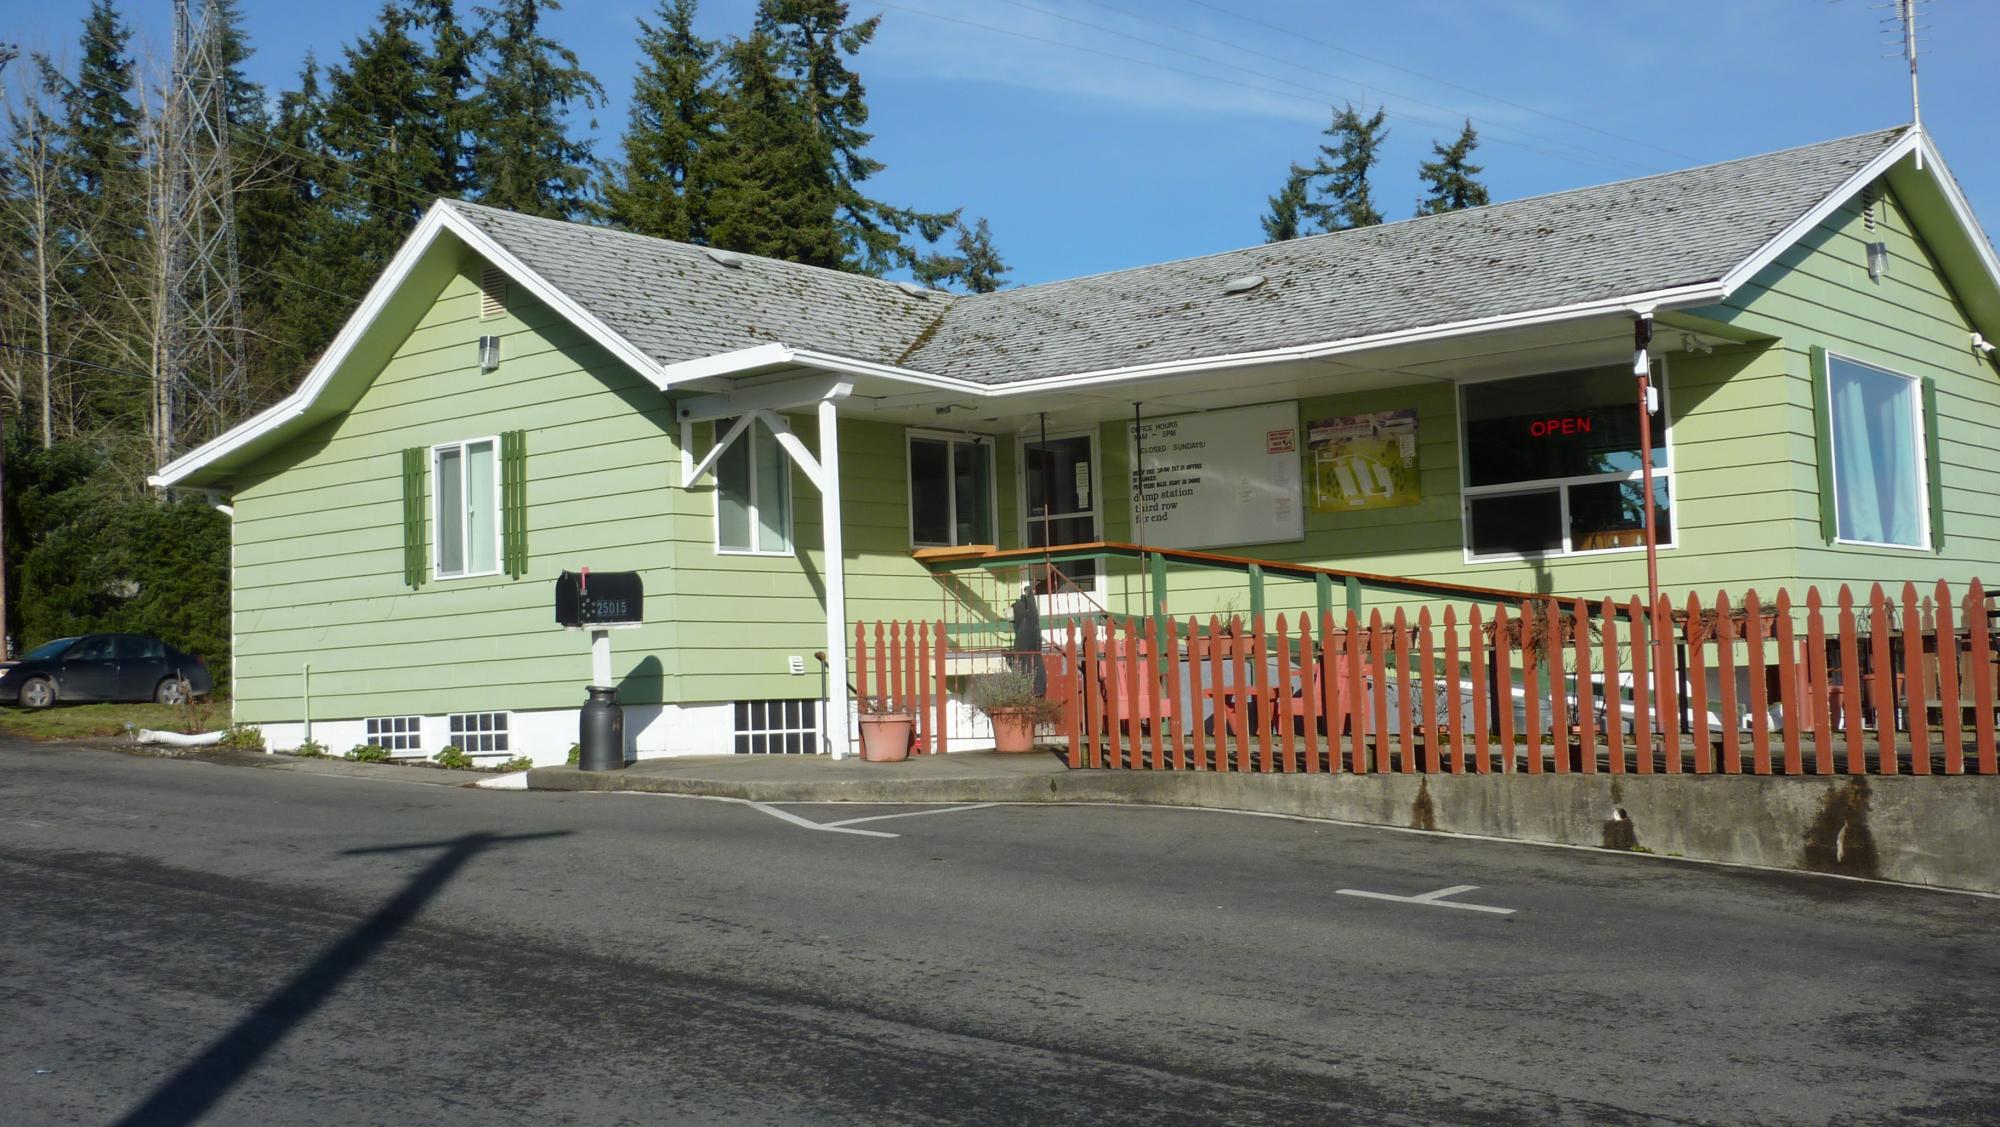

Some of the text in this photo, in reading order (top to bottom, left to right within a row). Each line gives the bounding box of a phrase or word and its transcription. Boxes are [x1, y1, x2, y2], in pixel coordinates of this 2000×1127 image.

[1156, 421, 1178, 430] HOURS
[1530, 416, 1592, 437] OPEN
[1140, 441, 1206, 454] CLOSED SUNDAYS!
[1160, 487, 1194, 498] station
[1161, 502, 1178, 510] row
[1150, 511, 1168, 522] end
[597, 601, 627, 615] 25015
